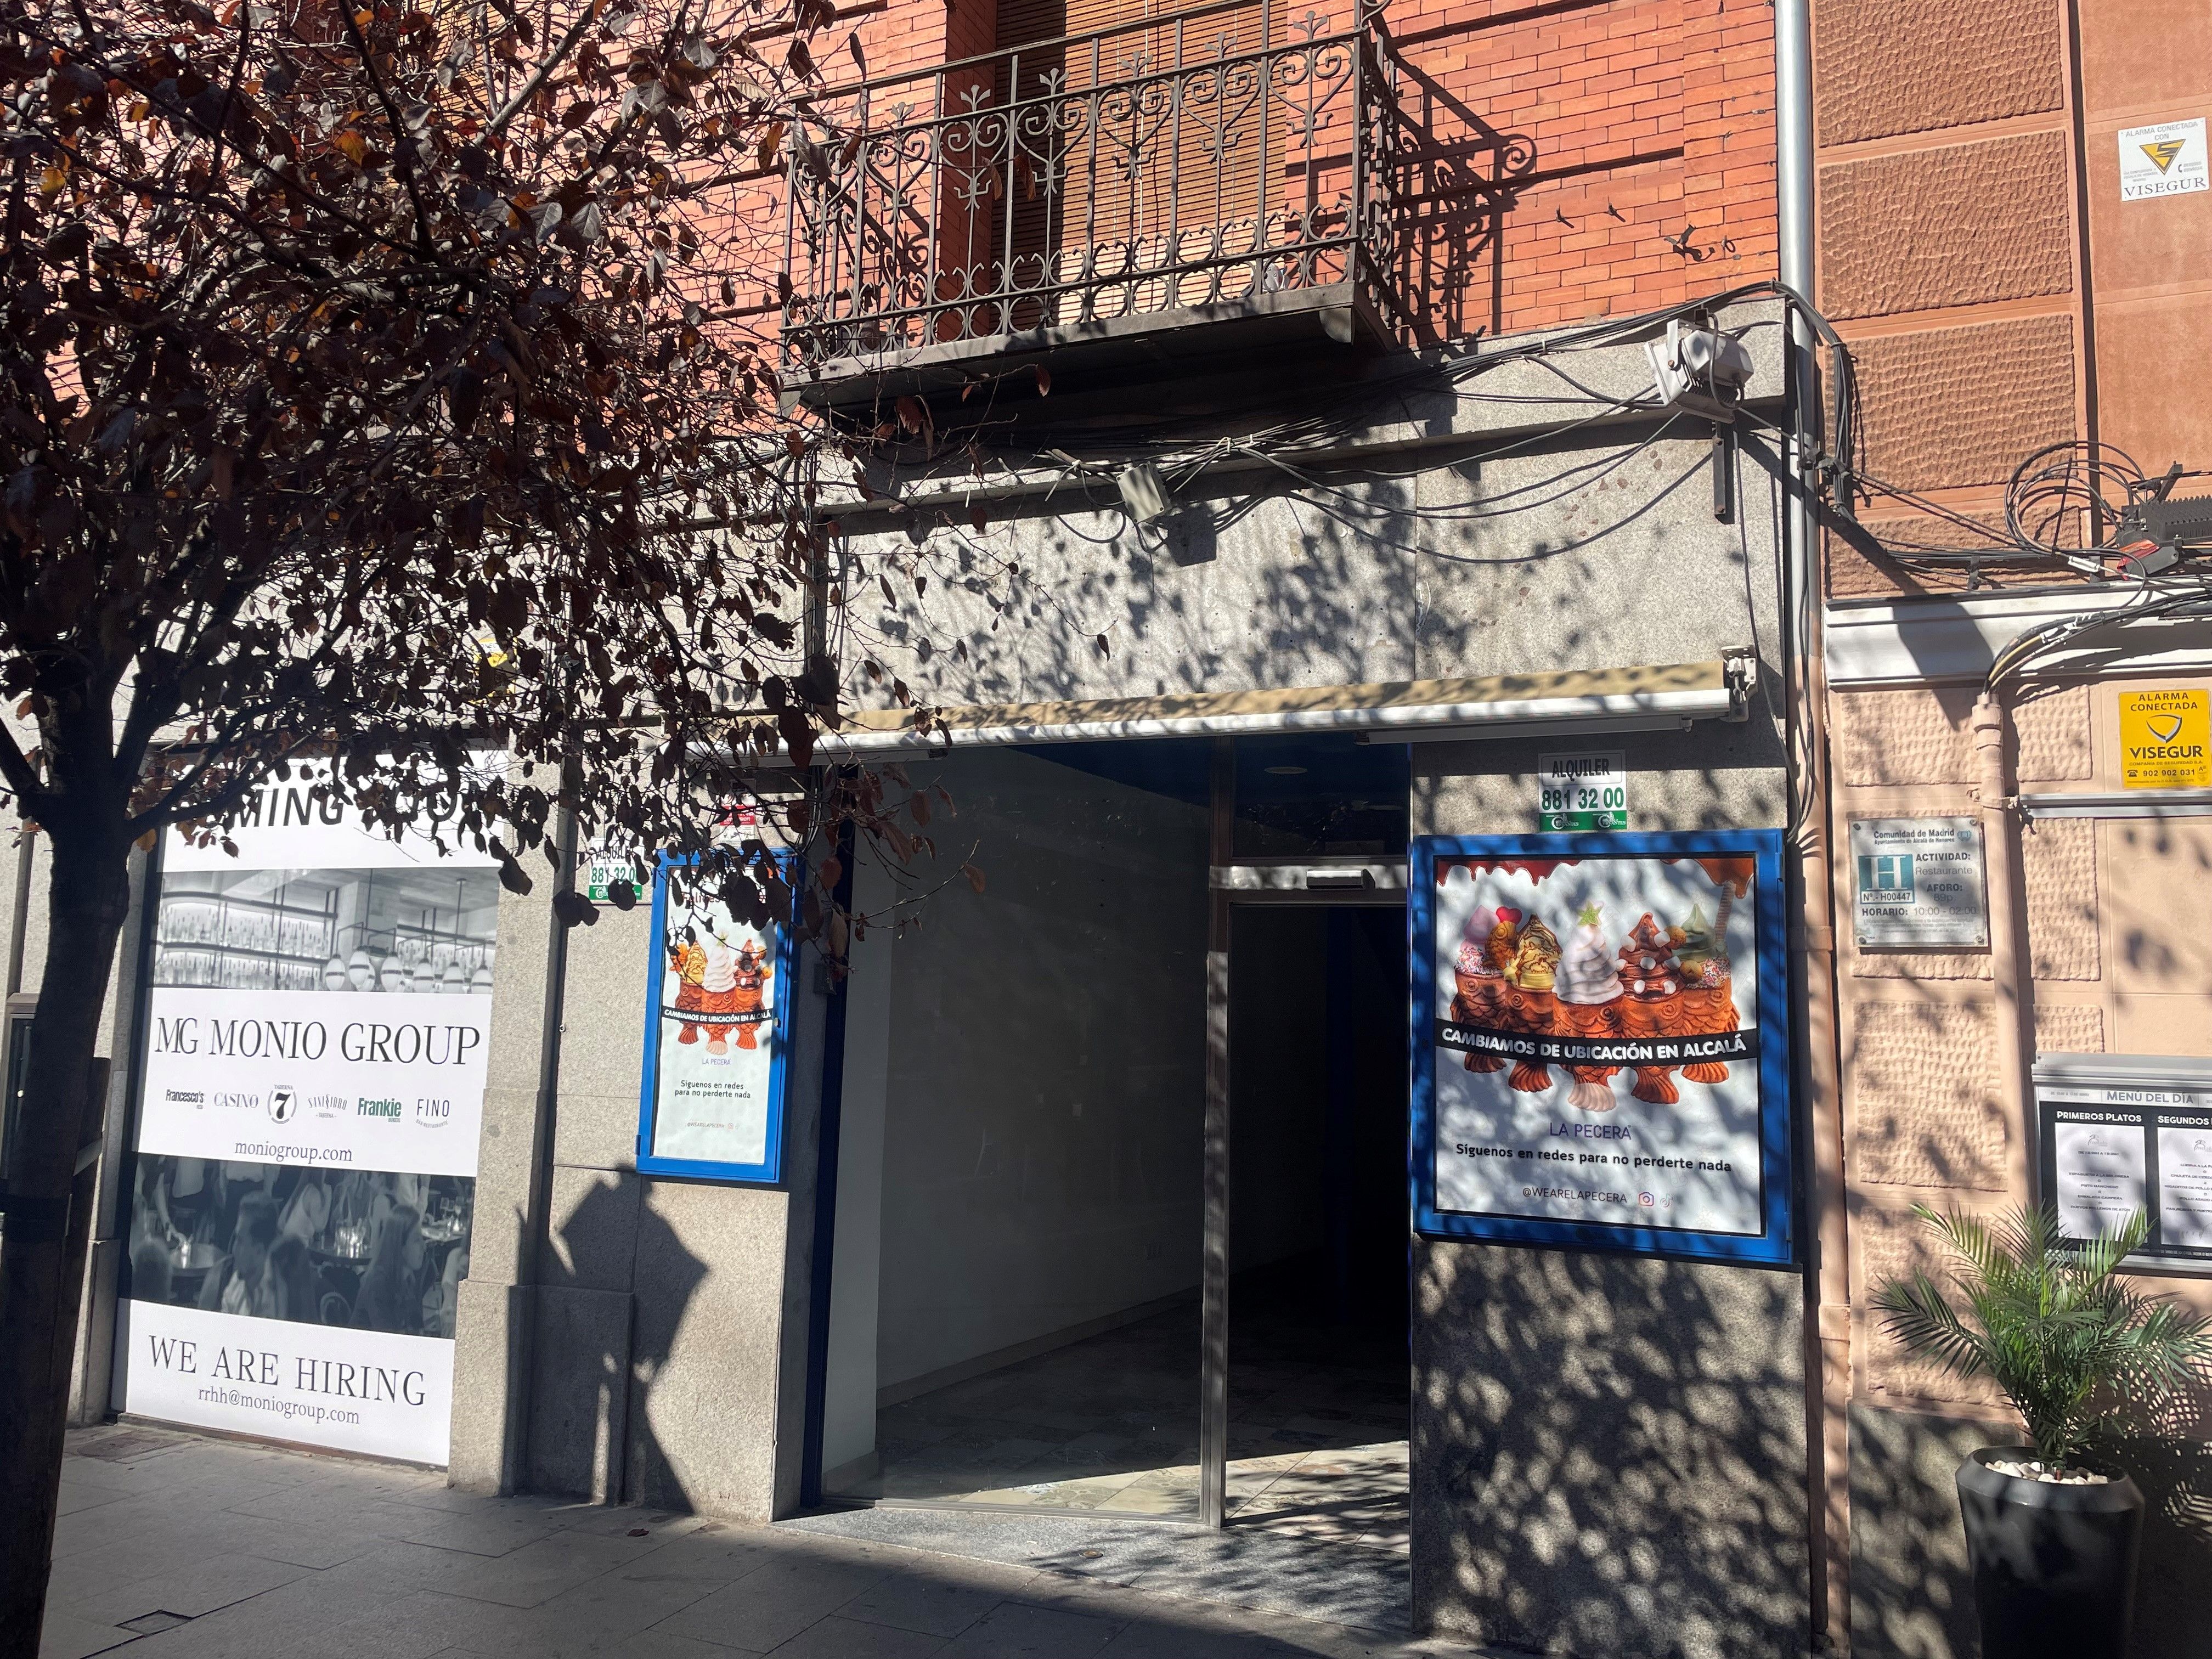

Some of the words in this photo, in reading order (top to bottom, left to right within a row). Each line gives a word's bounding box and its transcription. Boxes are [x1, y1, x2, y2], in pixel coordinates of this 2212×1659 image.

[2125, 128, 2155, 137] ALARMA
[2157, 121, 2198, 133] CONECTADA
[2124, 177, 2207, 197] VISEGUR
[2138, 692, 2189, 702] ALARMA
[2130, 702, 2198, 712] CONECTADA
[2129, 745, 2203, 759] VISEGUR
[1551, 758, 1611, 782] ALQUILER
[1542, 789, 1570, 810] 881
[1578, 788, 1598, 809] 32
[1604, 787, 1624, 808] 00
[1874, 830, 1915, 838] Comunidad
[1929, 828, 1954, 837] Madrid
[1916, 853, 1971, 861] ACTIVIDAD:
[591, 867, 609, 883] 881
[1915, 867, 1972, 875] Restaurante
[1927, 883, 1962, 891] AFORO:
[1881, 893, 1911, 901] H00447
[1862, 908, 1908, 916] HORARIO:
[1914, 907, 1940, 915] 10:00
[1949, 906, 1976, 915] 02:00
[664, 1009, 699, 1020] CAMBIAMOS
[708, 1013, 740, 1023] UBICACIÓN
[749, 1010, 771, 1020] ALCALÁ
[155, 1018, 198, 1054] MG
[208, 1019, 327, 1060] MONIO
[341, 1023, 479, 1065] GROUP
[1441, 1026, 1536, 1056] CAMBIAMOS
[1540, 1042, 1560, 1058] DE
[1564, 1042, 1653, 1060] UBICACIÓN
[1656, 1044, 1679, 1059] EN
[1683, 1034, 1747, 1057] ALCALÁ
[681, 1080, 712, 1088] Síguenos
[165, 1089, 204, 1103] Francesco's
[215, 1092, 258, 1108] CASINO
[2146, 1093, 2169, 1103] DEL
[275, 1092, 291, 1119] 7
[357, 1097, 402, 1117] Frankie
[416, 1099, 450, 1117] FINO
[2057, 1111, 2104, 1120] PRIMEROS
[2106, 1113, 2142, 1122] PLATOS
[2158, 1115, 2209, 1125] SEGUNDOS
[1549, 1122, 1570, 1137] LA
[1575, 1124, 1632, 1141] PECERA
[234, 1141, 353, 1164] moniogroup.com
[1455, 1143, 1513, 1159] Síguenos
[1517, 1149, 1534, 1159] en
[1538, 1149, 1575, 1162] redes
[1579, 1153, 1607, 1165] para
[1612, 1155, 1629, 1165] no
[1634, 1155, 1694, 1170] perderte
[1698, 1158, 1731, 1172] nada
[1522, 1186, 1627, 1204] @WEARELAPECERA
[149, 1335, 198, 1373] WE
[211, 1346, 279, 1386] ARE
[295, 1357, 426, 1406] HIRING
[198, 1386, 360, 1425] rrhh@moniogroup.com
